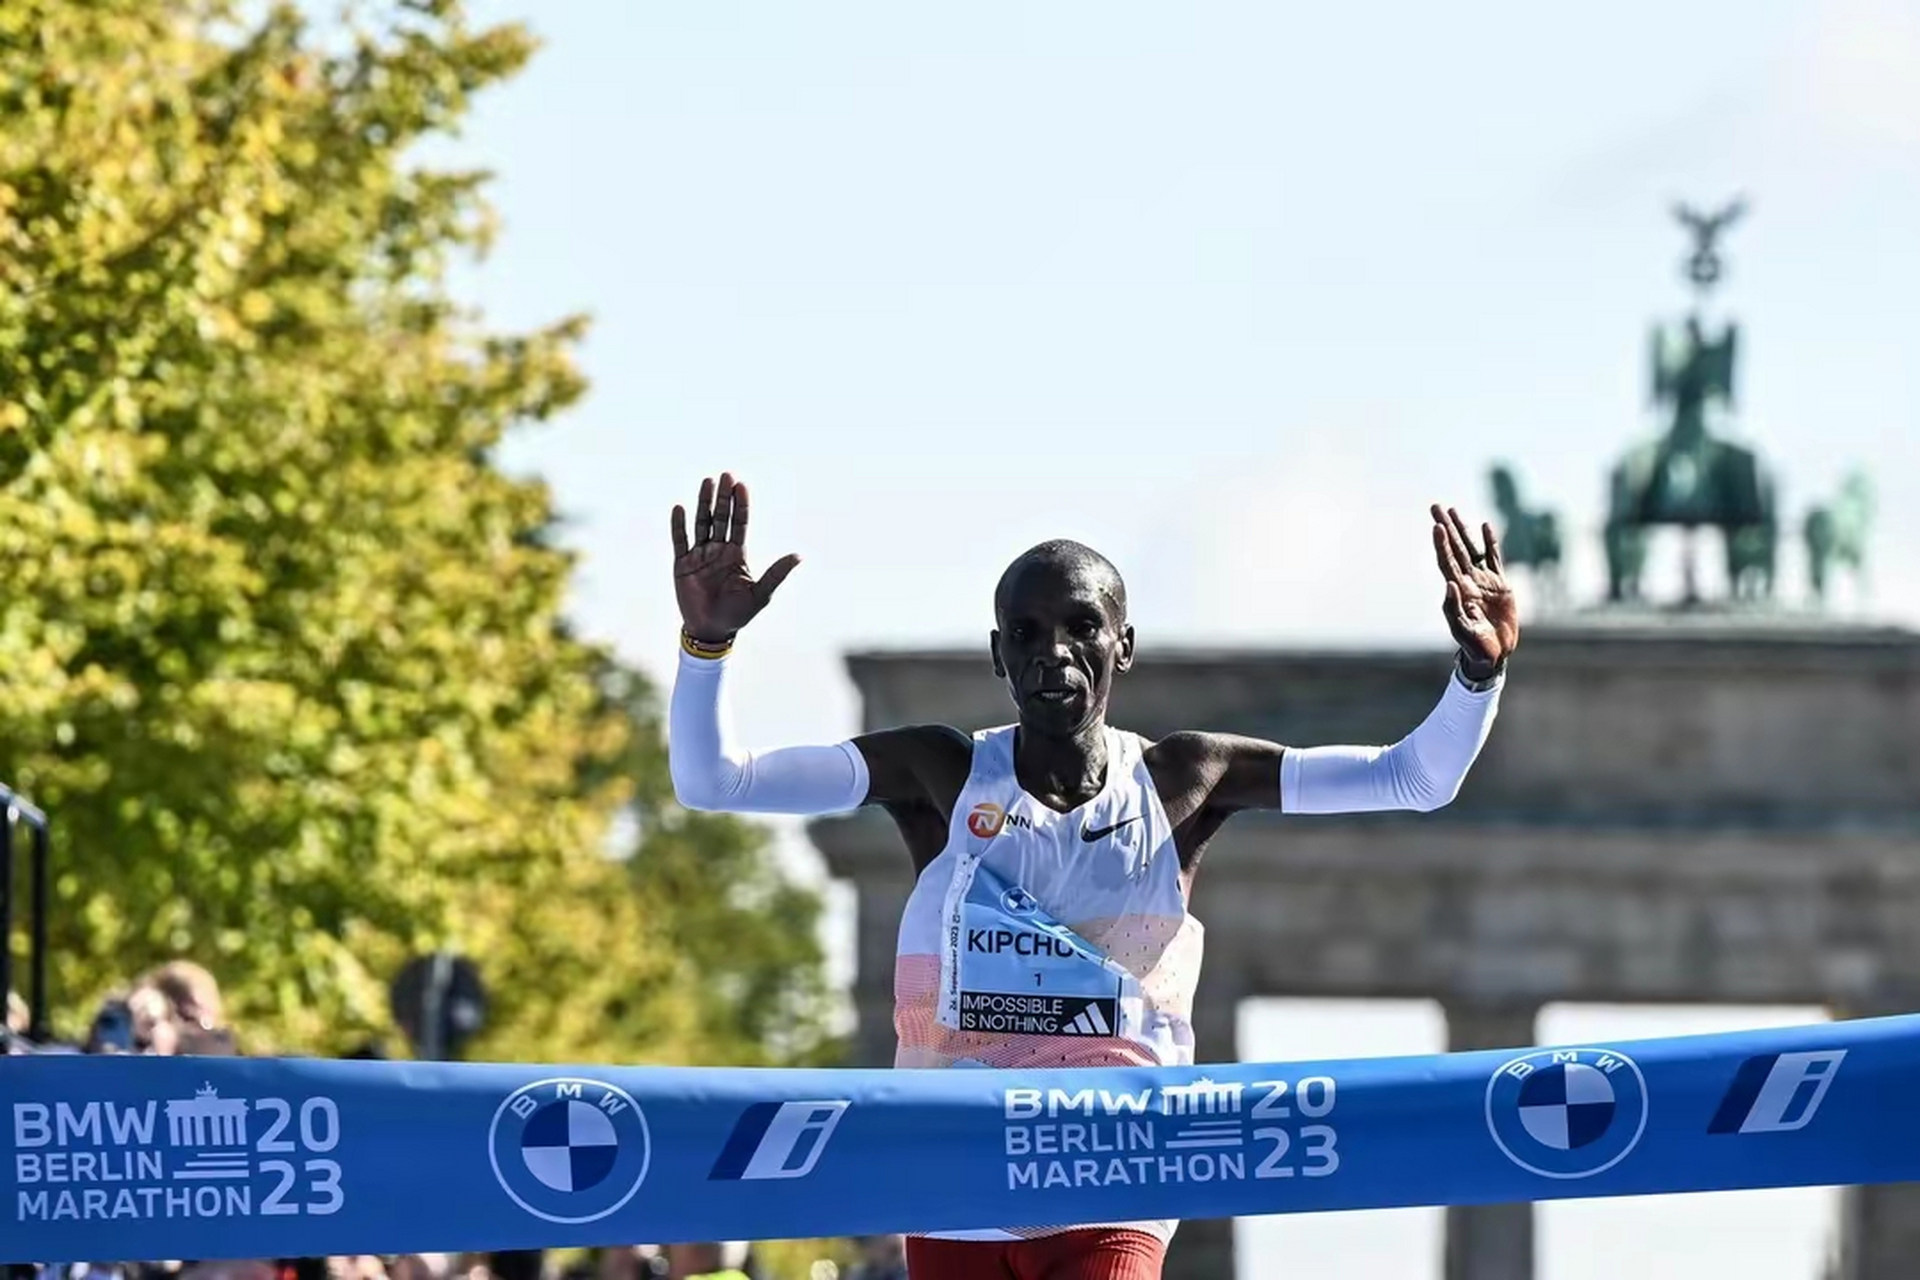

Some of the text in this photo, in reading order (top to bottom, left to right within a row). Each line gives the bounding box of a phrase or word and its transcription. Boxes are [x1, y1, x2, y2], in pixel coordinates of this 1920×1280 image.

[1006, 814, 1031, 830] NN
[951, 926, 960, 948] 2023
[967, 929, 1088, 961] KIPCHO
[1034, 972, 1042, 987] 1
[963, 994, 1063, 1015] IMPOSSIBLE
[962, 1013, 1058, 1033] IS NOTHING
[1506, 1051, 1624, 1081] BMW
[510, 1082, 627, 1121] BMW
[1004, 1088, 1152, 1120] BMW
[1250, 1076, 1336, 1119] 20
[13, 1100, 157, 1147] BMW
[255, 1096, 340, 1152] 20
[1005, 1121, 1155, 1155] BERLIN
[16, 1151, 163, 1183] BERLIN
[1252, 1125, 1340, 1179] 23
[258, 1158, 344, 1215] 23
[1007, 1153, 1246, 1190] MARATHON
[17, 1185, 251, 1221] MARATHON
